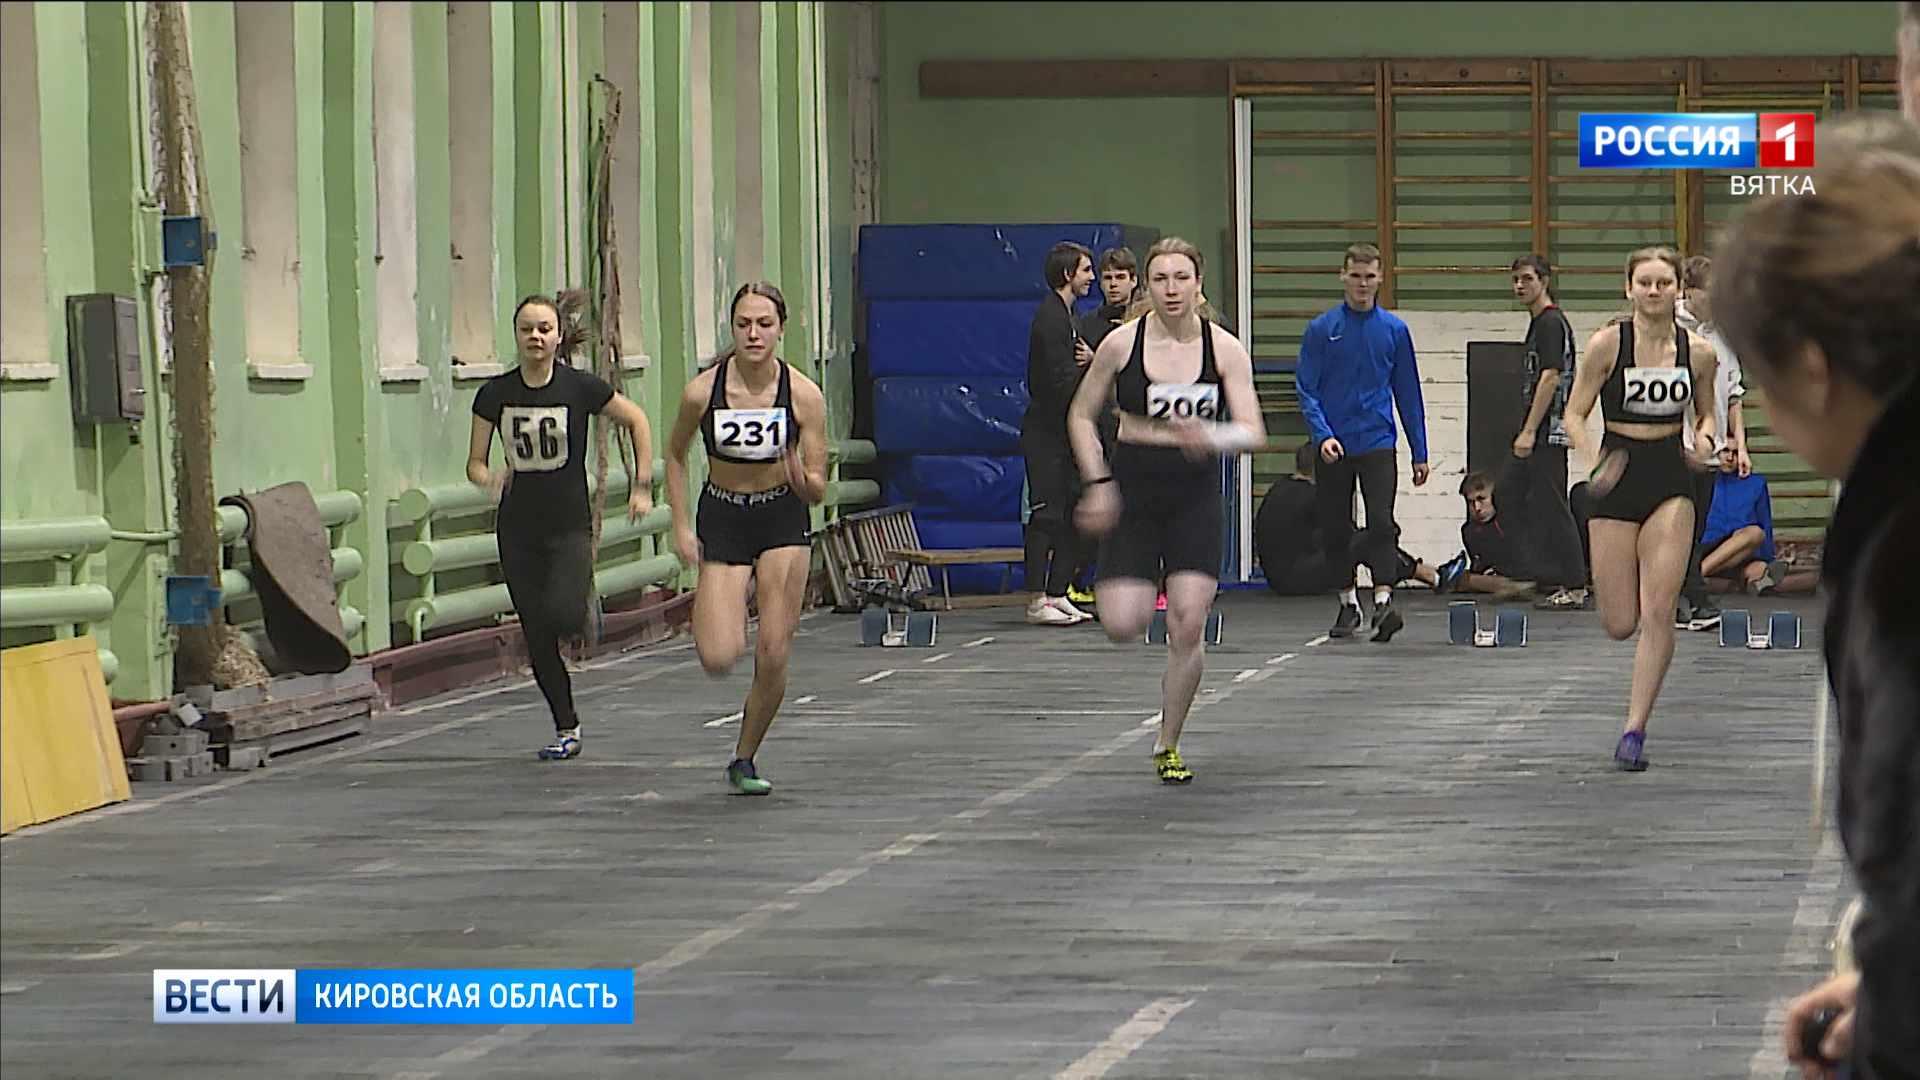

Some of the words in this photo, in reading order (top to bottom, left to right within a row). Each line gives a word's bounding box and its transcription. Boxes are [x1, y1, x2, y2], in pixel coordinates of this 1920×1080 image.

[1627, 380, 1689, 403] 200
[1152, 397, 1214, 419] 206
[511, 416, 558, 460] 56
[721, 420, 780, 446] 231
[706, 485, 745, 505] NIKE
[749, 483, 789, 505] PRO
